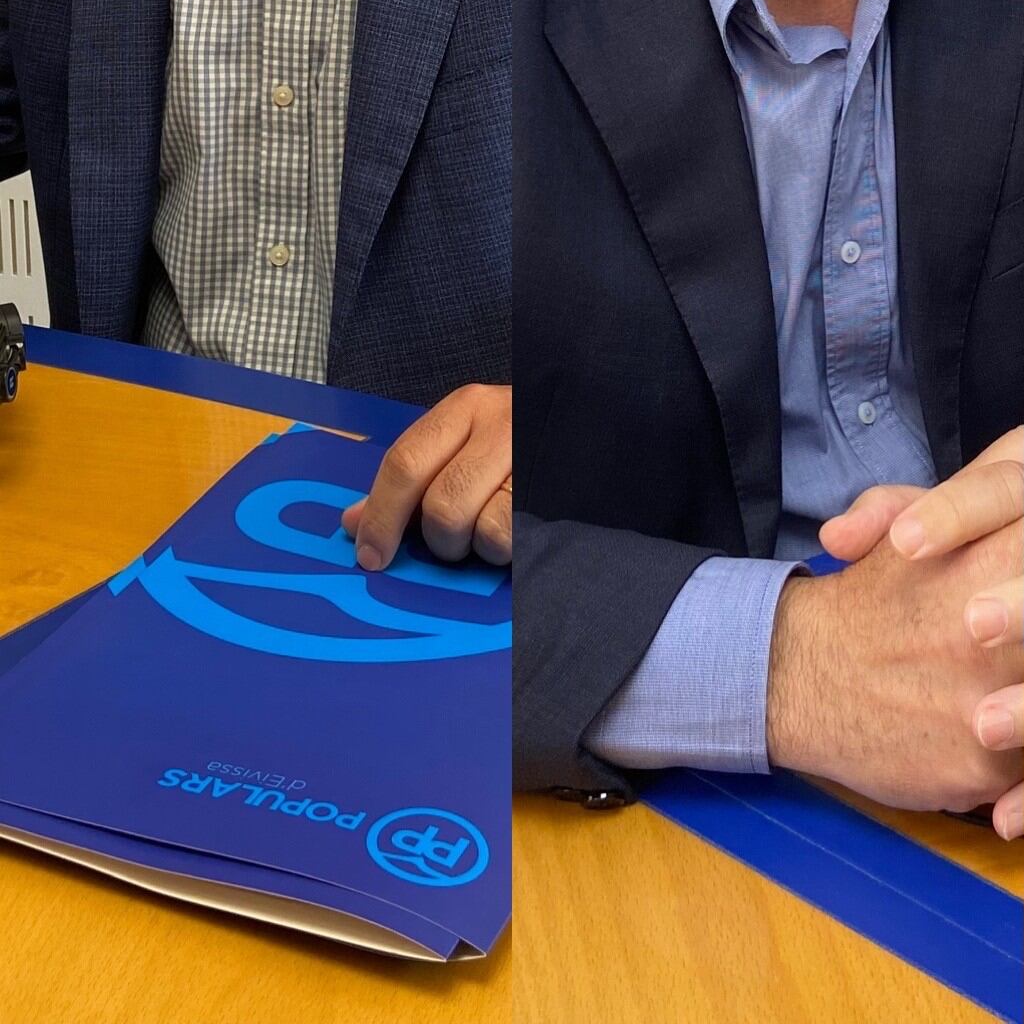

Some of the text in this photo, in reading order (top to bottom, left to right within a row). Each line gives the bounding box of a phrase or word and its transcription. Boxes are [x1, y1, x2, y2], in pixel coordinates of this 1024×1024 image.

[207, 760, 306, 792] d'Eivissa
[157, 767, 366, 831] POPULARS
[391, 824, 470, 869] PP
